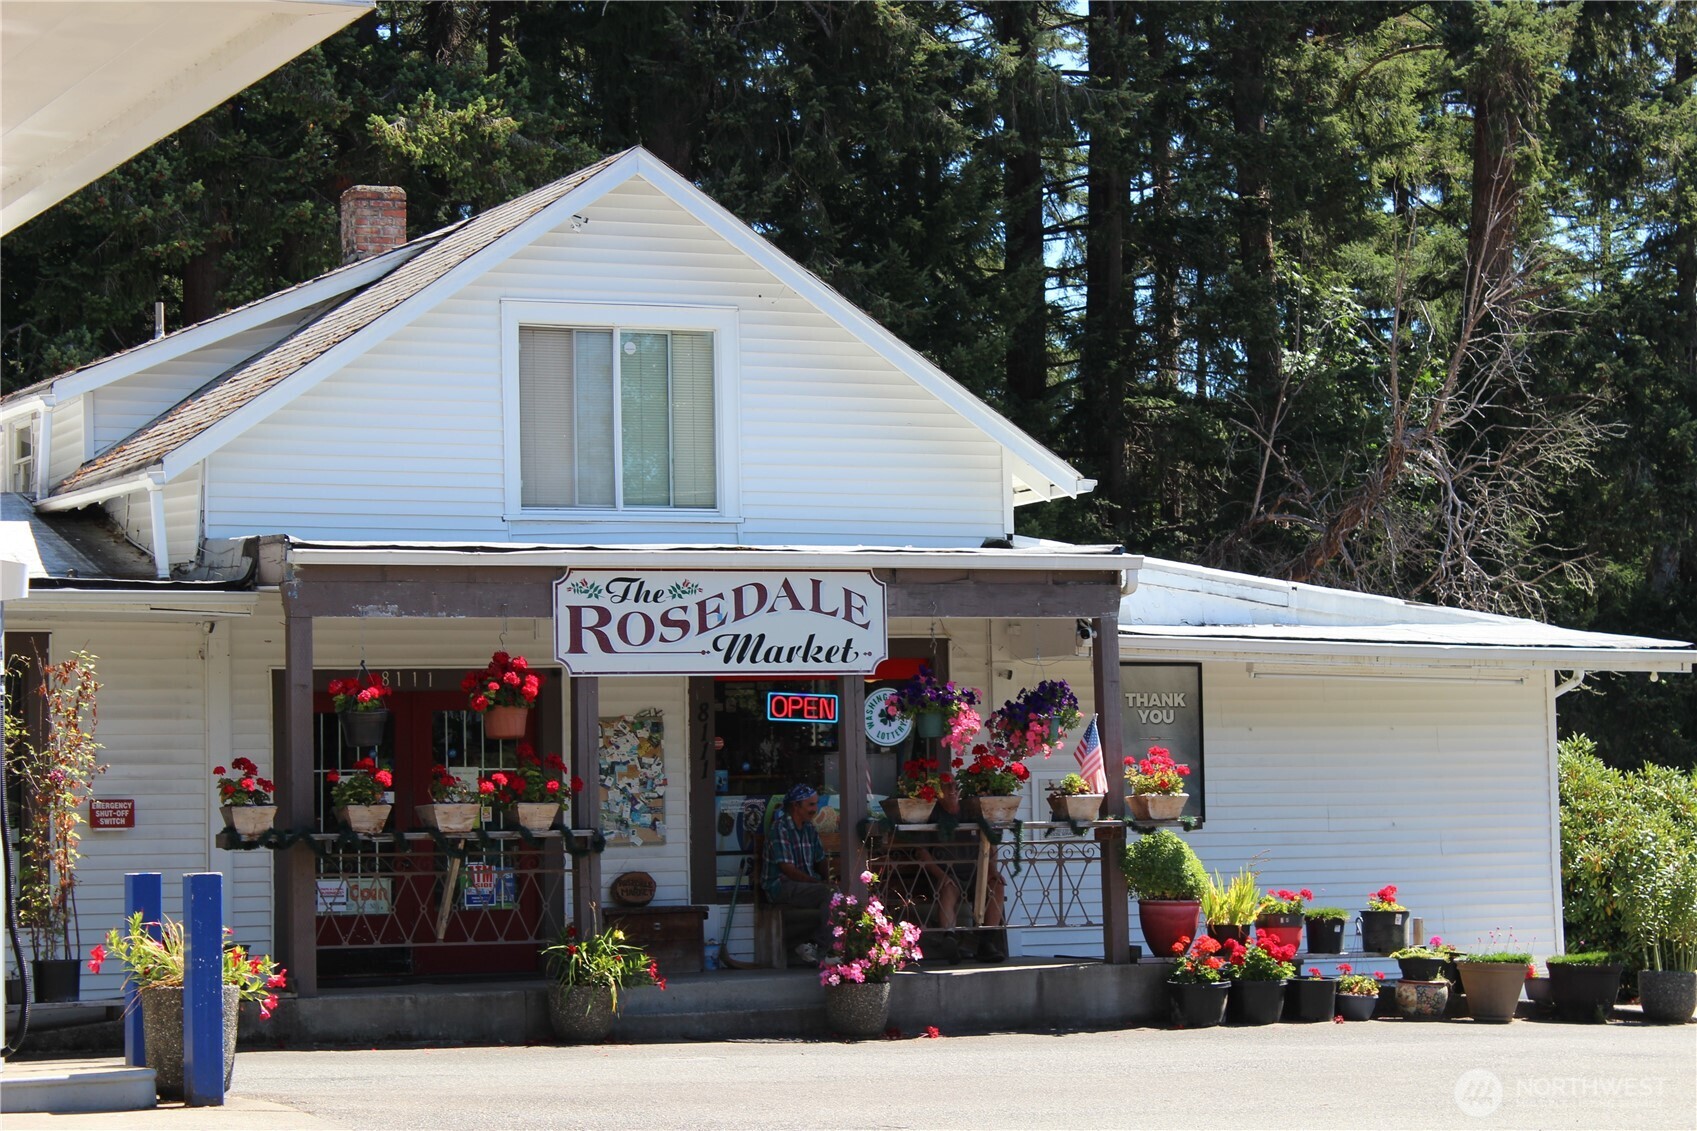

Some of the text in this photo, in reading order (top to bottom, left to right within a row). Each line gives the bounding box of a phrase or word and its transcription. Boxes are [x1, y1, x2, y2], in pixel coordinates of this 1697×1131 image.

[605, 576, 666, 604] The
[564, 576, 871, 655] ROSEDALE
[712, 633, 859, 665] Market
[381, 671, 432, 688] 8111
[771, 695, 835, 720] OPEN
[1125, 693, 1186, 707] THANK
[1137, 709, 1175, 725] YOU
[697, 702, 709, 779] 8111
[876, 720, 907, 740] LOTTERY
